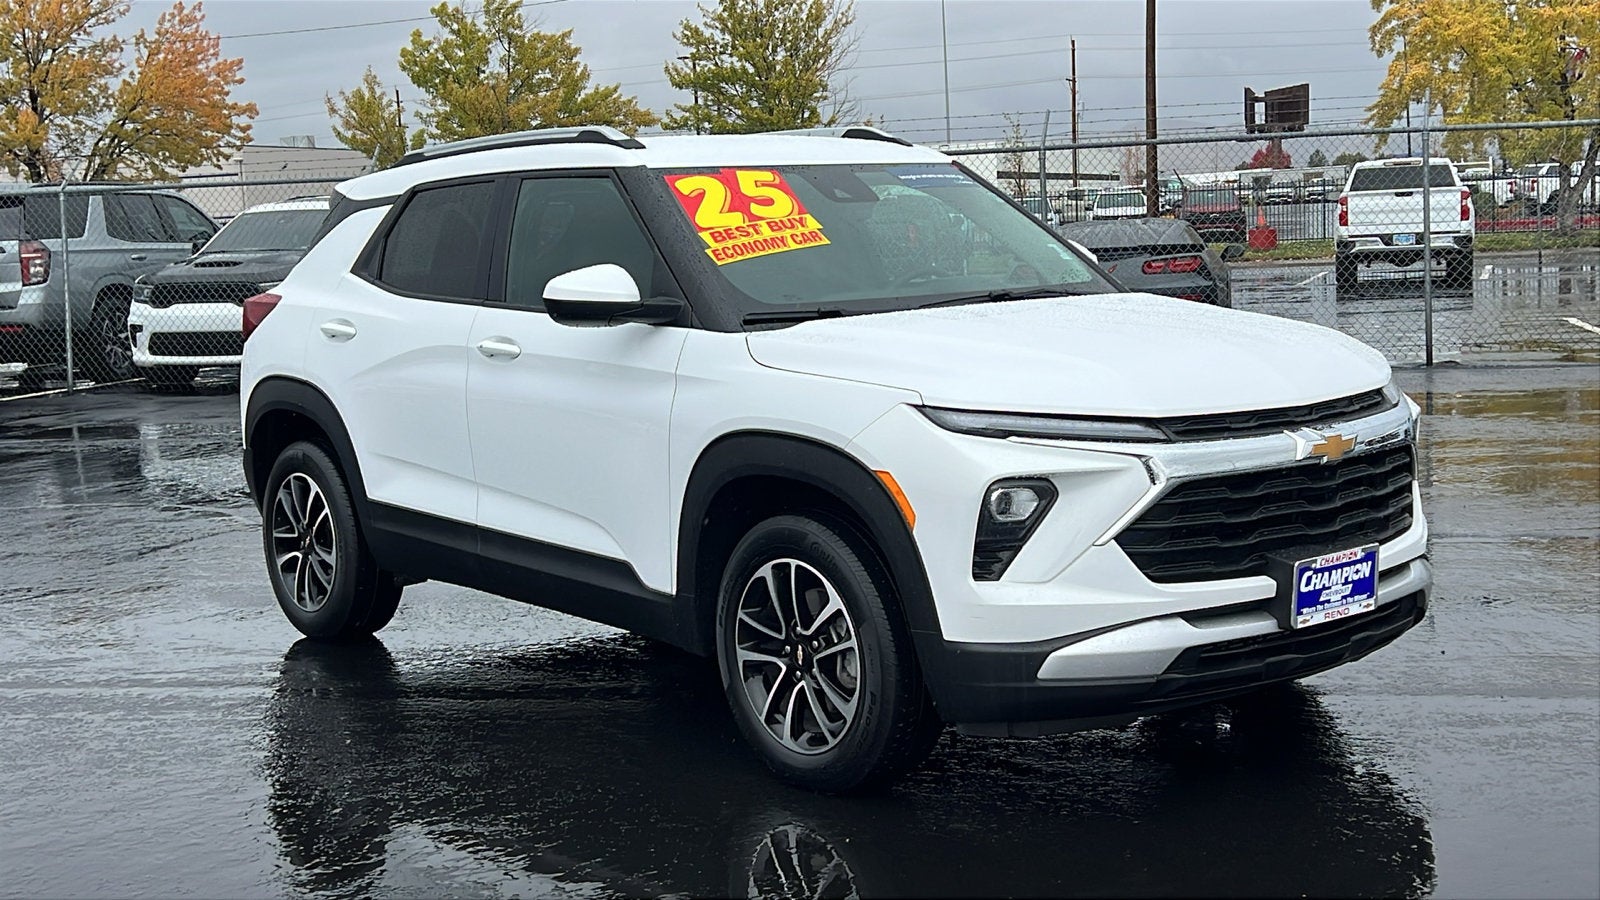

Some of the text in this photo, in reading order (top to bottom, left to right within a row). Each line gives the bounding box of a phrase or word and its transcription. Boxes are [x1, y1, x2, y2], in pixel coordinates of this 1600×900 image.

[674, 170, 799, 229] 25
[709, 216, 809, 244] BEST BUY
[711, 230, 823, 262] ECONOMY CAR
[1319, 551, 1358, 567] CHAMPION
[1300, 560, 1372, 593] CHAMPION
[1324, 607, 1350, 619] RENO
